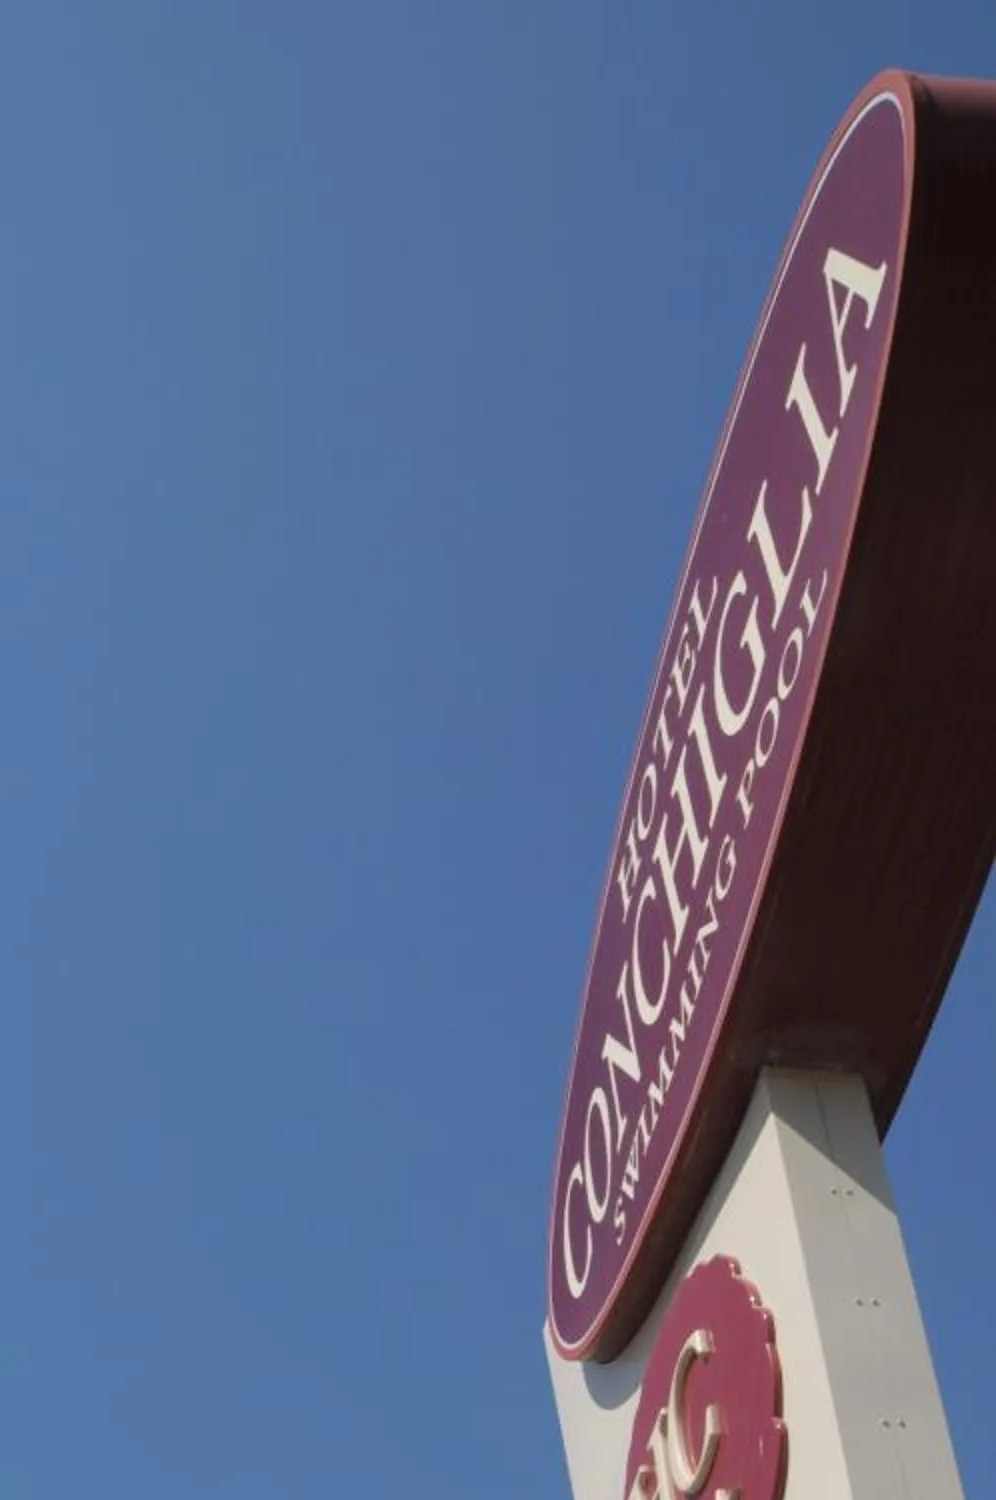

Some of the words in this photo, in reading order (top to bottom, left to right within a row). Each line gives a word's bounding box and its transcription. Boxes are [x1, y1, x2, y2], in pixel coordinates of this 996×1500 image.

[562, 246, 887, 1299] CONCHIGLIA
[612, 835, 736, 1246] SWIMMING
[735, 567, 828, 829] POOL
[616, 574, 718, 922] HOTEL
